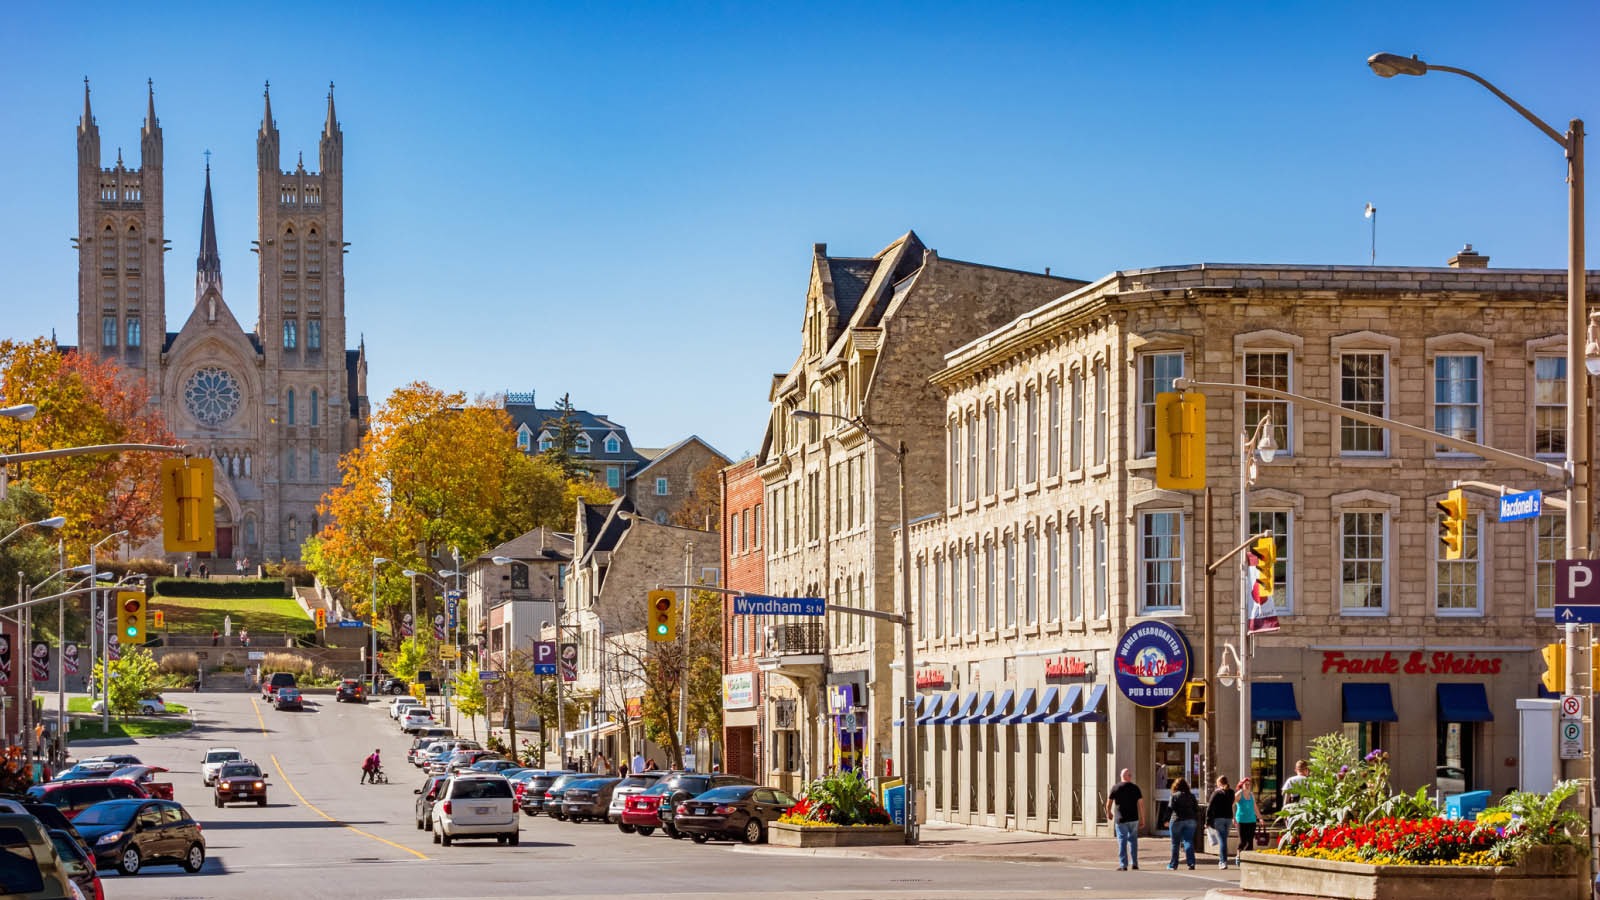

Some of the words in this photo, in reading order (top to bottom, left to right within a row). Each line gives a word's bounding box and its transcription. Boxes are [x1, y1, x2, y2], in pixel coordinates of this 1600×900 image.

[1501, 495, 1533, 518] Macdonell
[1568, 566, 1592, 599] P
[737, 599, 802, 614] Wyndham
[806, 604, 814, 613] St
[816, 605, 822, 613] N
[1120, 631, 1139, 656] WORLD
[1137, 627, 1181, 656] HEADQUARTERS
[538, 645, 551, 661] P
[1147, 661, 1153, 677] &
[1321, 651, 1399, 674] Frank
[1403, 651, 1427, 674] &
[1429, 651, 1503, 675] Steins
[1128, 687, 1144, 696] PUB
[1146, 688, 1152, 696] &
[1153, 687, 1174, 696] GRUB
